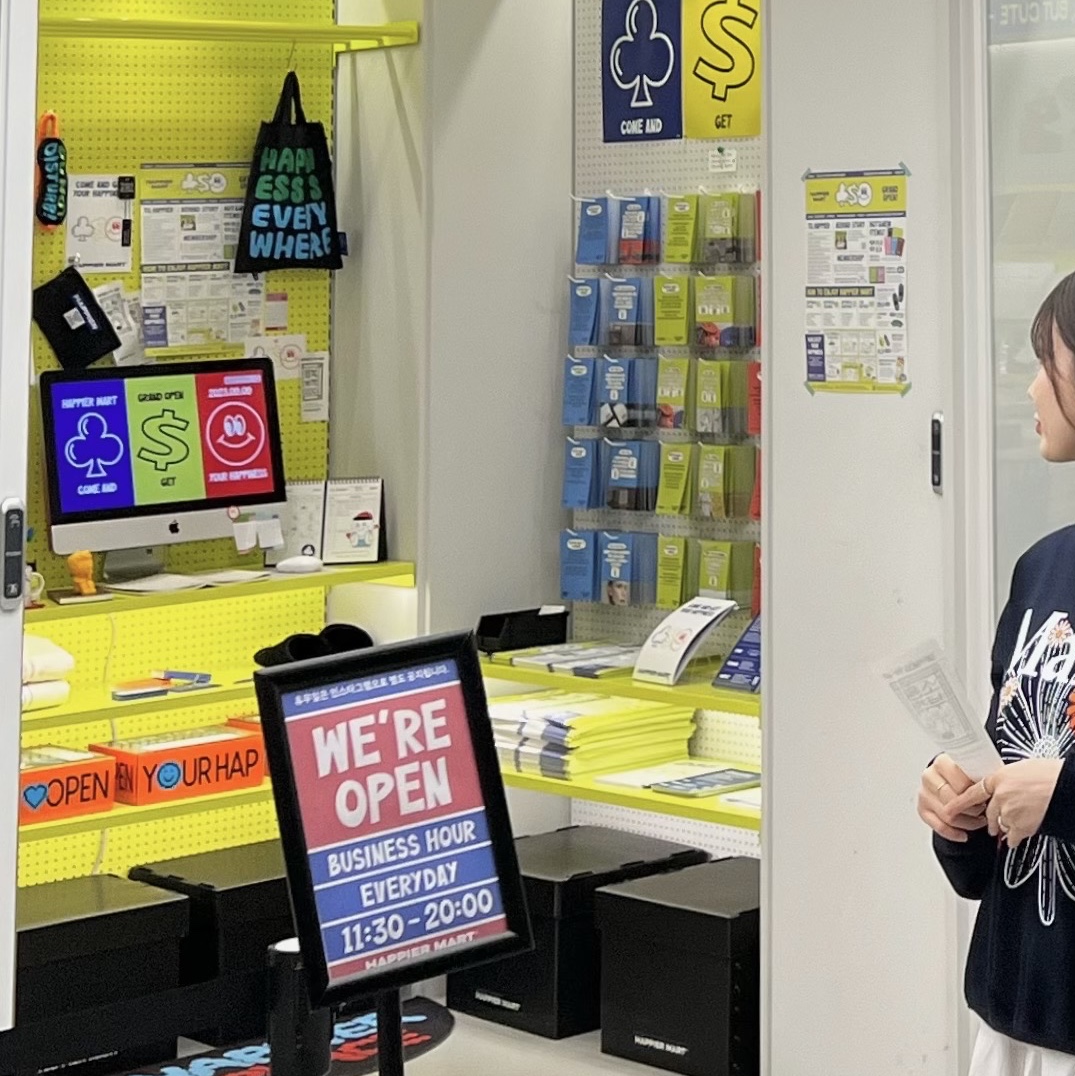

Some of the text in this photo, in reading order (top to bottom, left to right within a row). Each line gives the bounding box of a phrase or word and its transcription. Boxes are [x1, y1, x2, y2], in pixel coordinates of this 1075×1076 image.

[620, 118, 663, 135] COME AND
[714, 114, 733, 129] GET
[249, 227, 331, 260] WHERE
[78, 483, 100, 495] COME
[160, 477, 176, 487] GET
[312, 698, 452, 779] WE'RE
[46, 770, 109, 807] OPEN
[334, 756, 453, 829] OPEN
[327, 820, 476, 877] BUSINESS HOUR
[359, 861, 458, 908] EVERYDAY
[434, 931, 479, 951] MART
